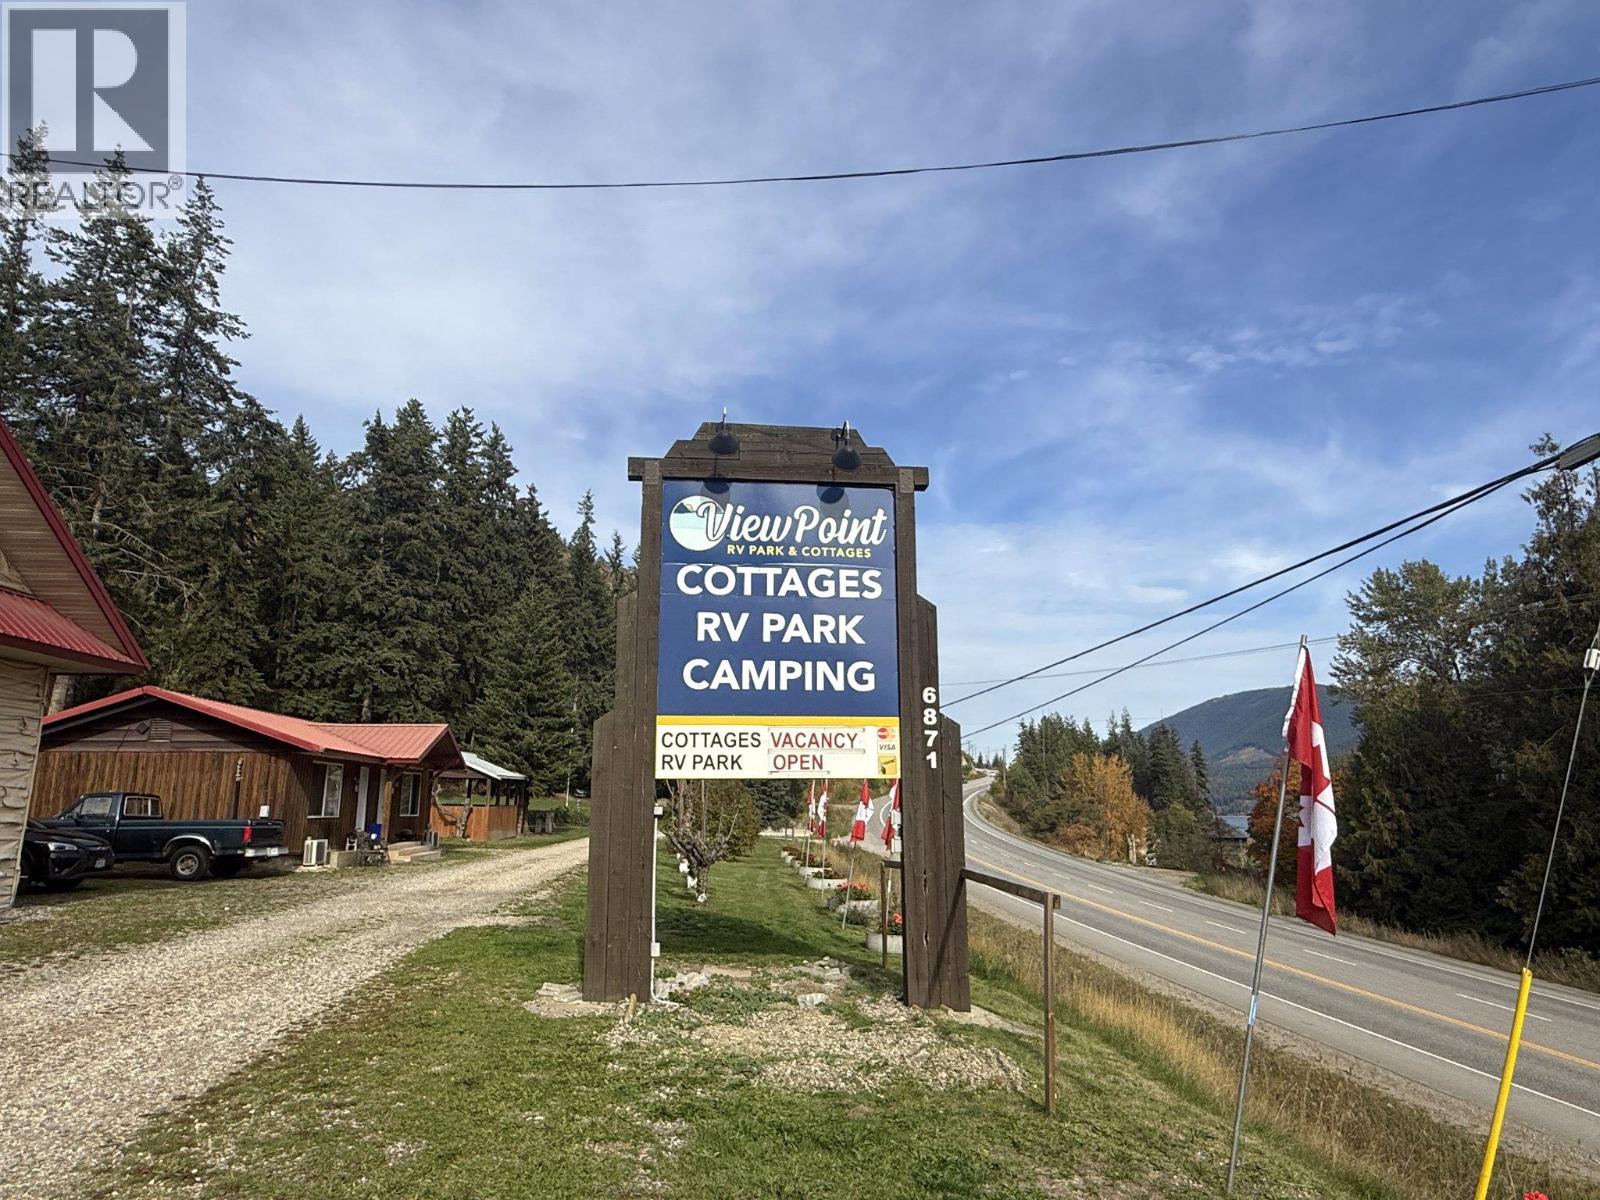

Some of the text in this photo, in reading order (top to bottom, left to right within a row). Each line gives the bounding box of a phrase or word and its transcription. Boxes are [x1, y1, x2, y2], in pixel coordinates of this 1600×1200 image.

[727, 545, 872, 559] RV PARK & COTTAGES
[676, 564, 883, 600] COTTAGES
[697, 612, 866, 645] RV PARK
[682, 658, 876, 692] CAMPING
[661, 731, 858, 749] COTTAGES VACANCY
[661, 754, 824, 770] RV PARK OPEN
